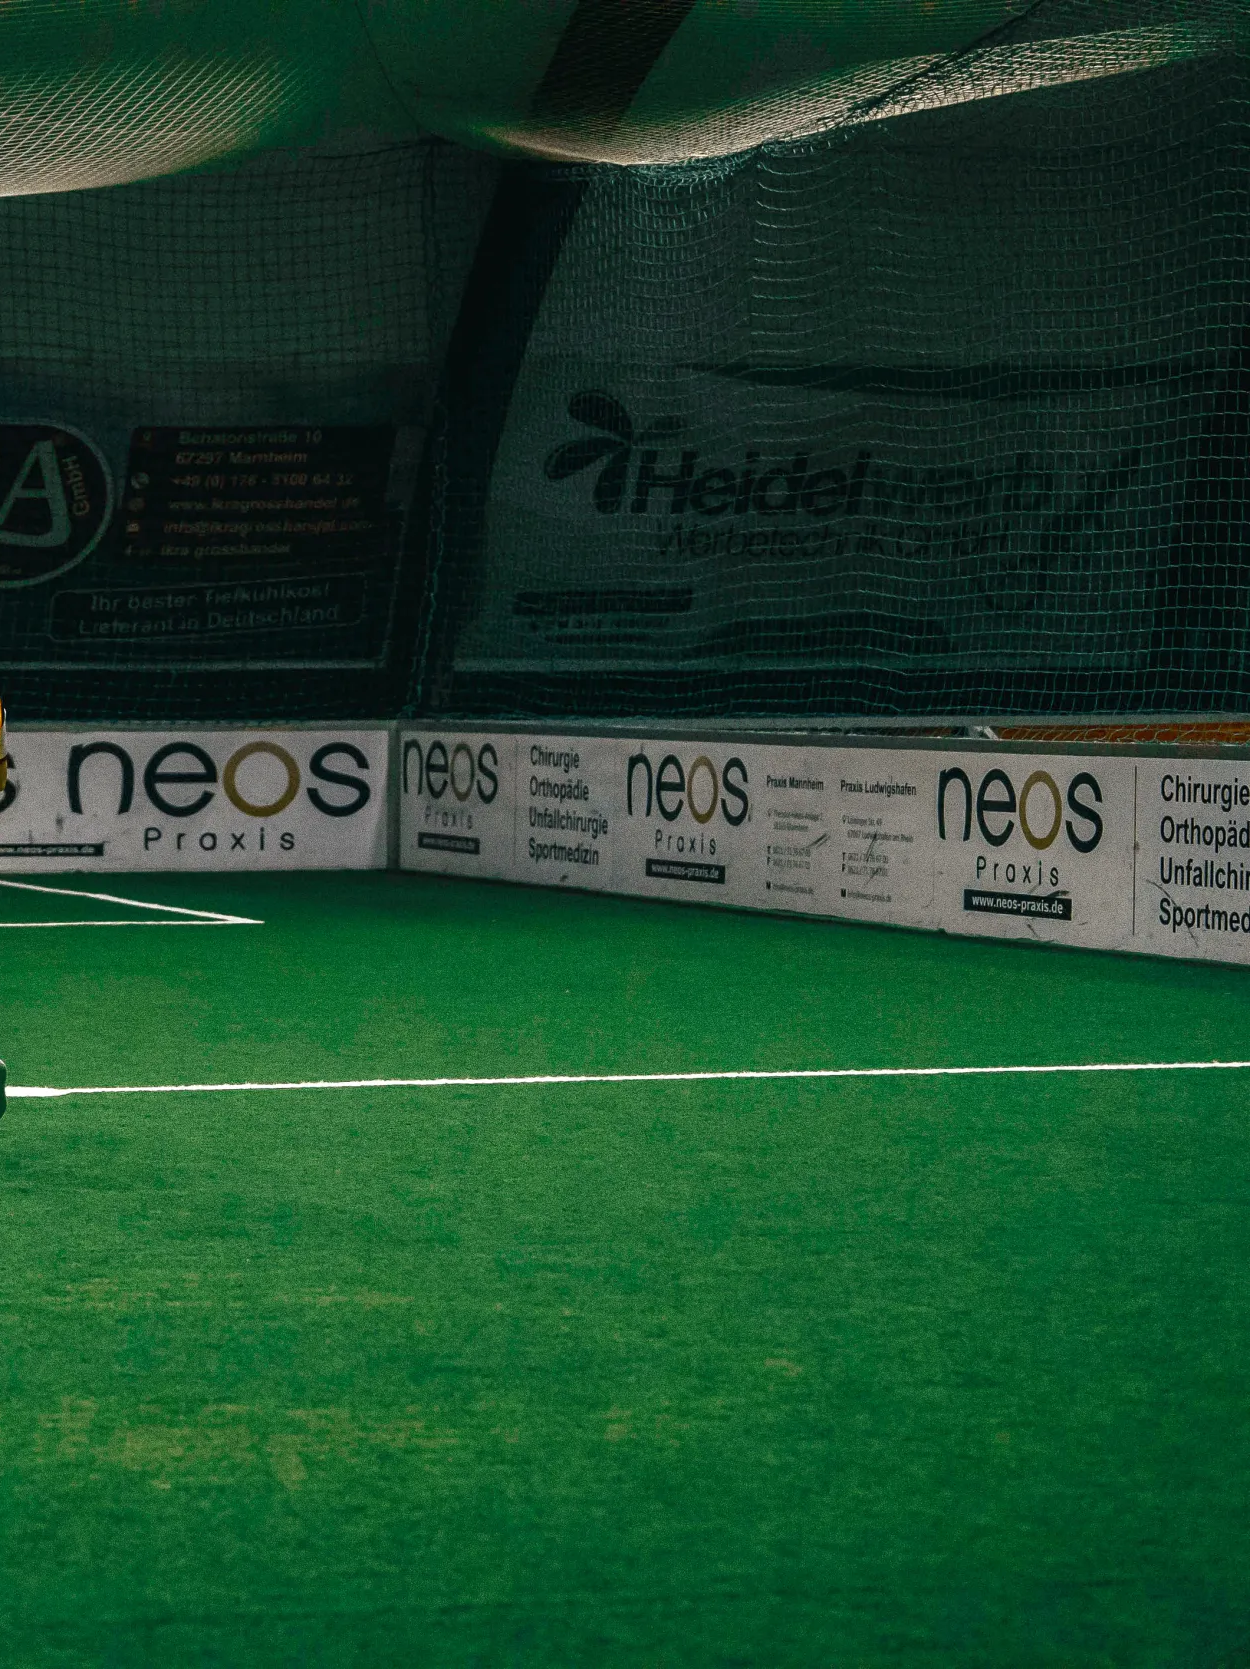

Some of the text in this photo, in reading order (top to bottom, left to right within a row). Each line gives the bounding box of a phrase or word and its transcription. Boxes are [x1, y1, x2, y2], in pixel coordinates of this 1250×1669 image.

[402, 739, 499, 804] neos
[529, 745, 580, 772] Chirurgie
[68, 740, 371, 818] neos
[529, 775, 589, 803] Orthopädie
[626, 754, 748, 827] neos
[766, 774, 824, 791] Praxis Mannheim
[840, 779, 917, 797] Praxis Ludwigshafen
[1161, 774, 1250, 812] Chirurgie
[528, 806, 608, 840] Unfallchirurgie
[937, 766, 1104, 853] neos
[144, 827, 296, 852] Praxis
[528, 837, 599, 865] Sportmedizin
[655, 829, 717, 856] Praxis
[976, 855, 1060, 887] Praxis
[972, 894, 1064, 915] www.neos-praxis.de
